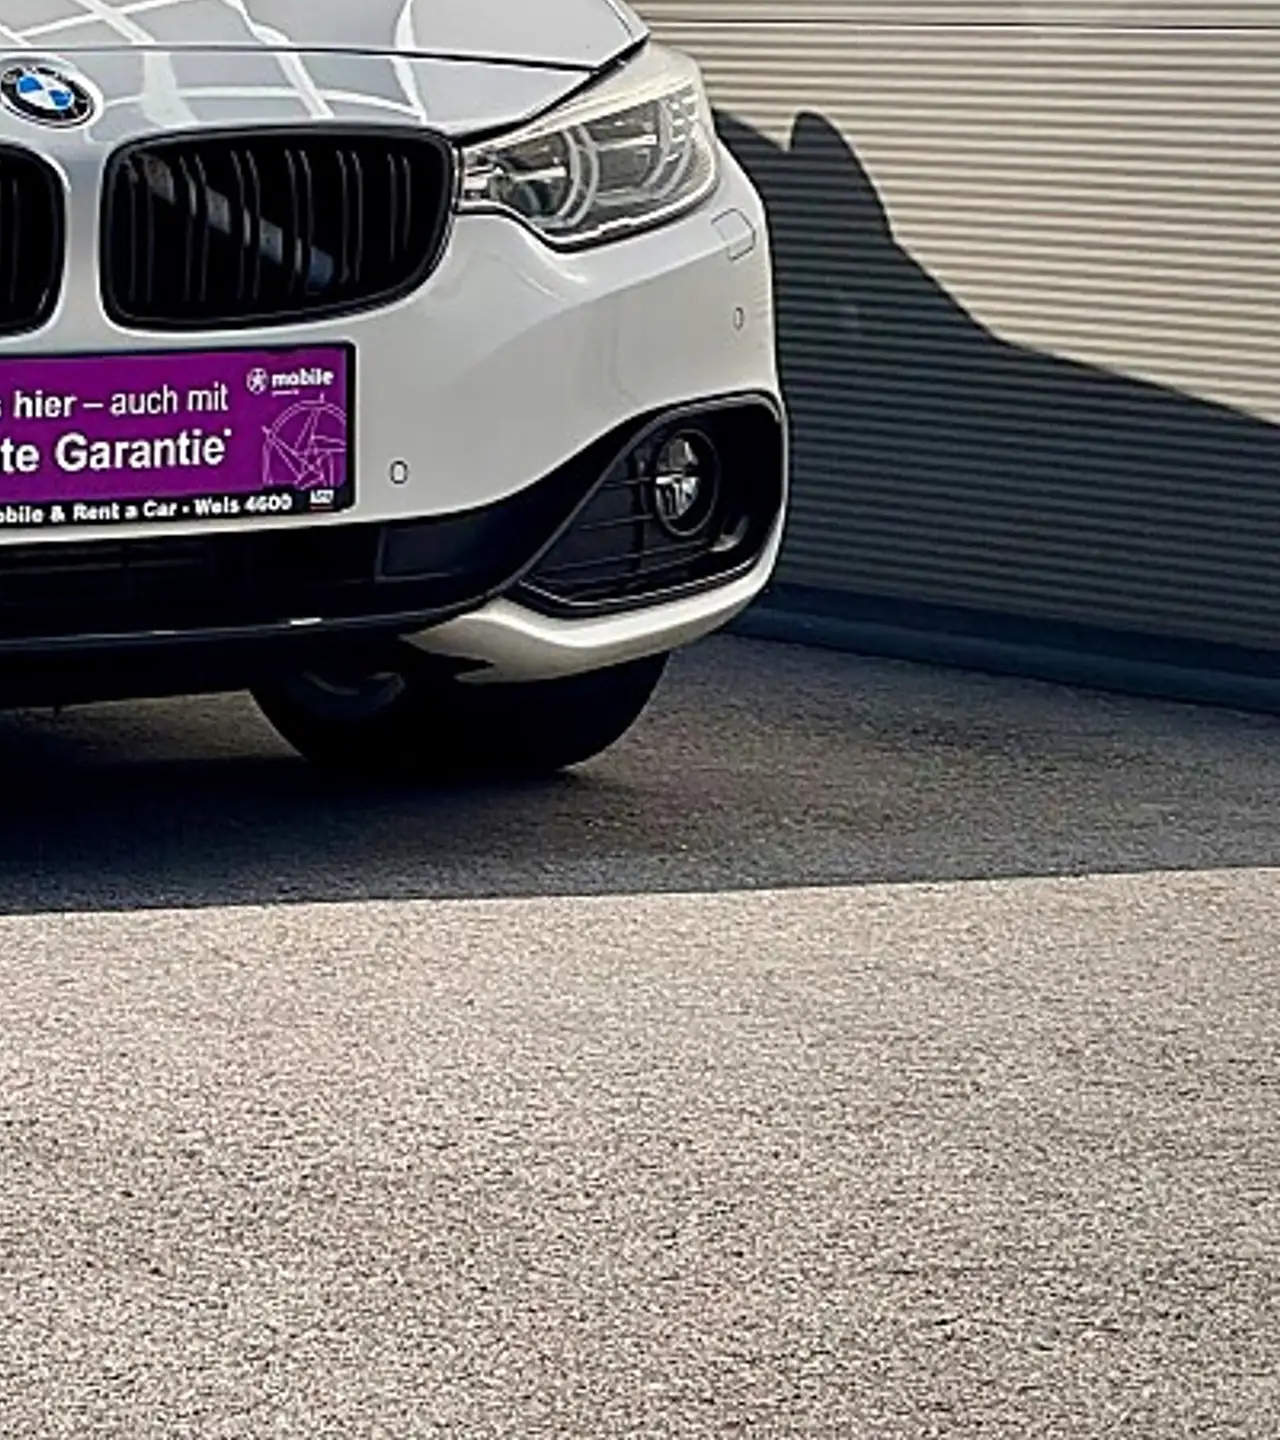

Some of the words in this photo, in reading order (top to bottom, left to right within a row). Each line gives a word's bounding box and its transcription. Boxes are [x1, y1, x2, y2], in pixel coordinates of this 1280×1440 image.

[271, 368, 334, 388] mobile
[13, 391, 77, 418] hier
[110, 385, 177, 415] auch
[187, 382, 228, 411] mit
[51, 506, 65, 522] &
[73, 502, 120, 521] Rent
[125, 504, 138, 519] a
[143, 500, 177, 518] Car
[244, 494, 293, 513] 4600
